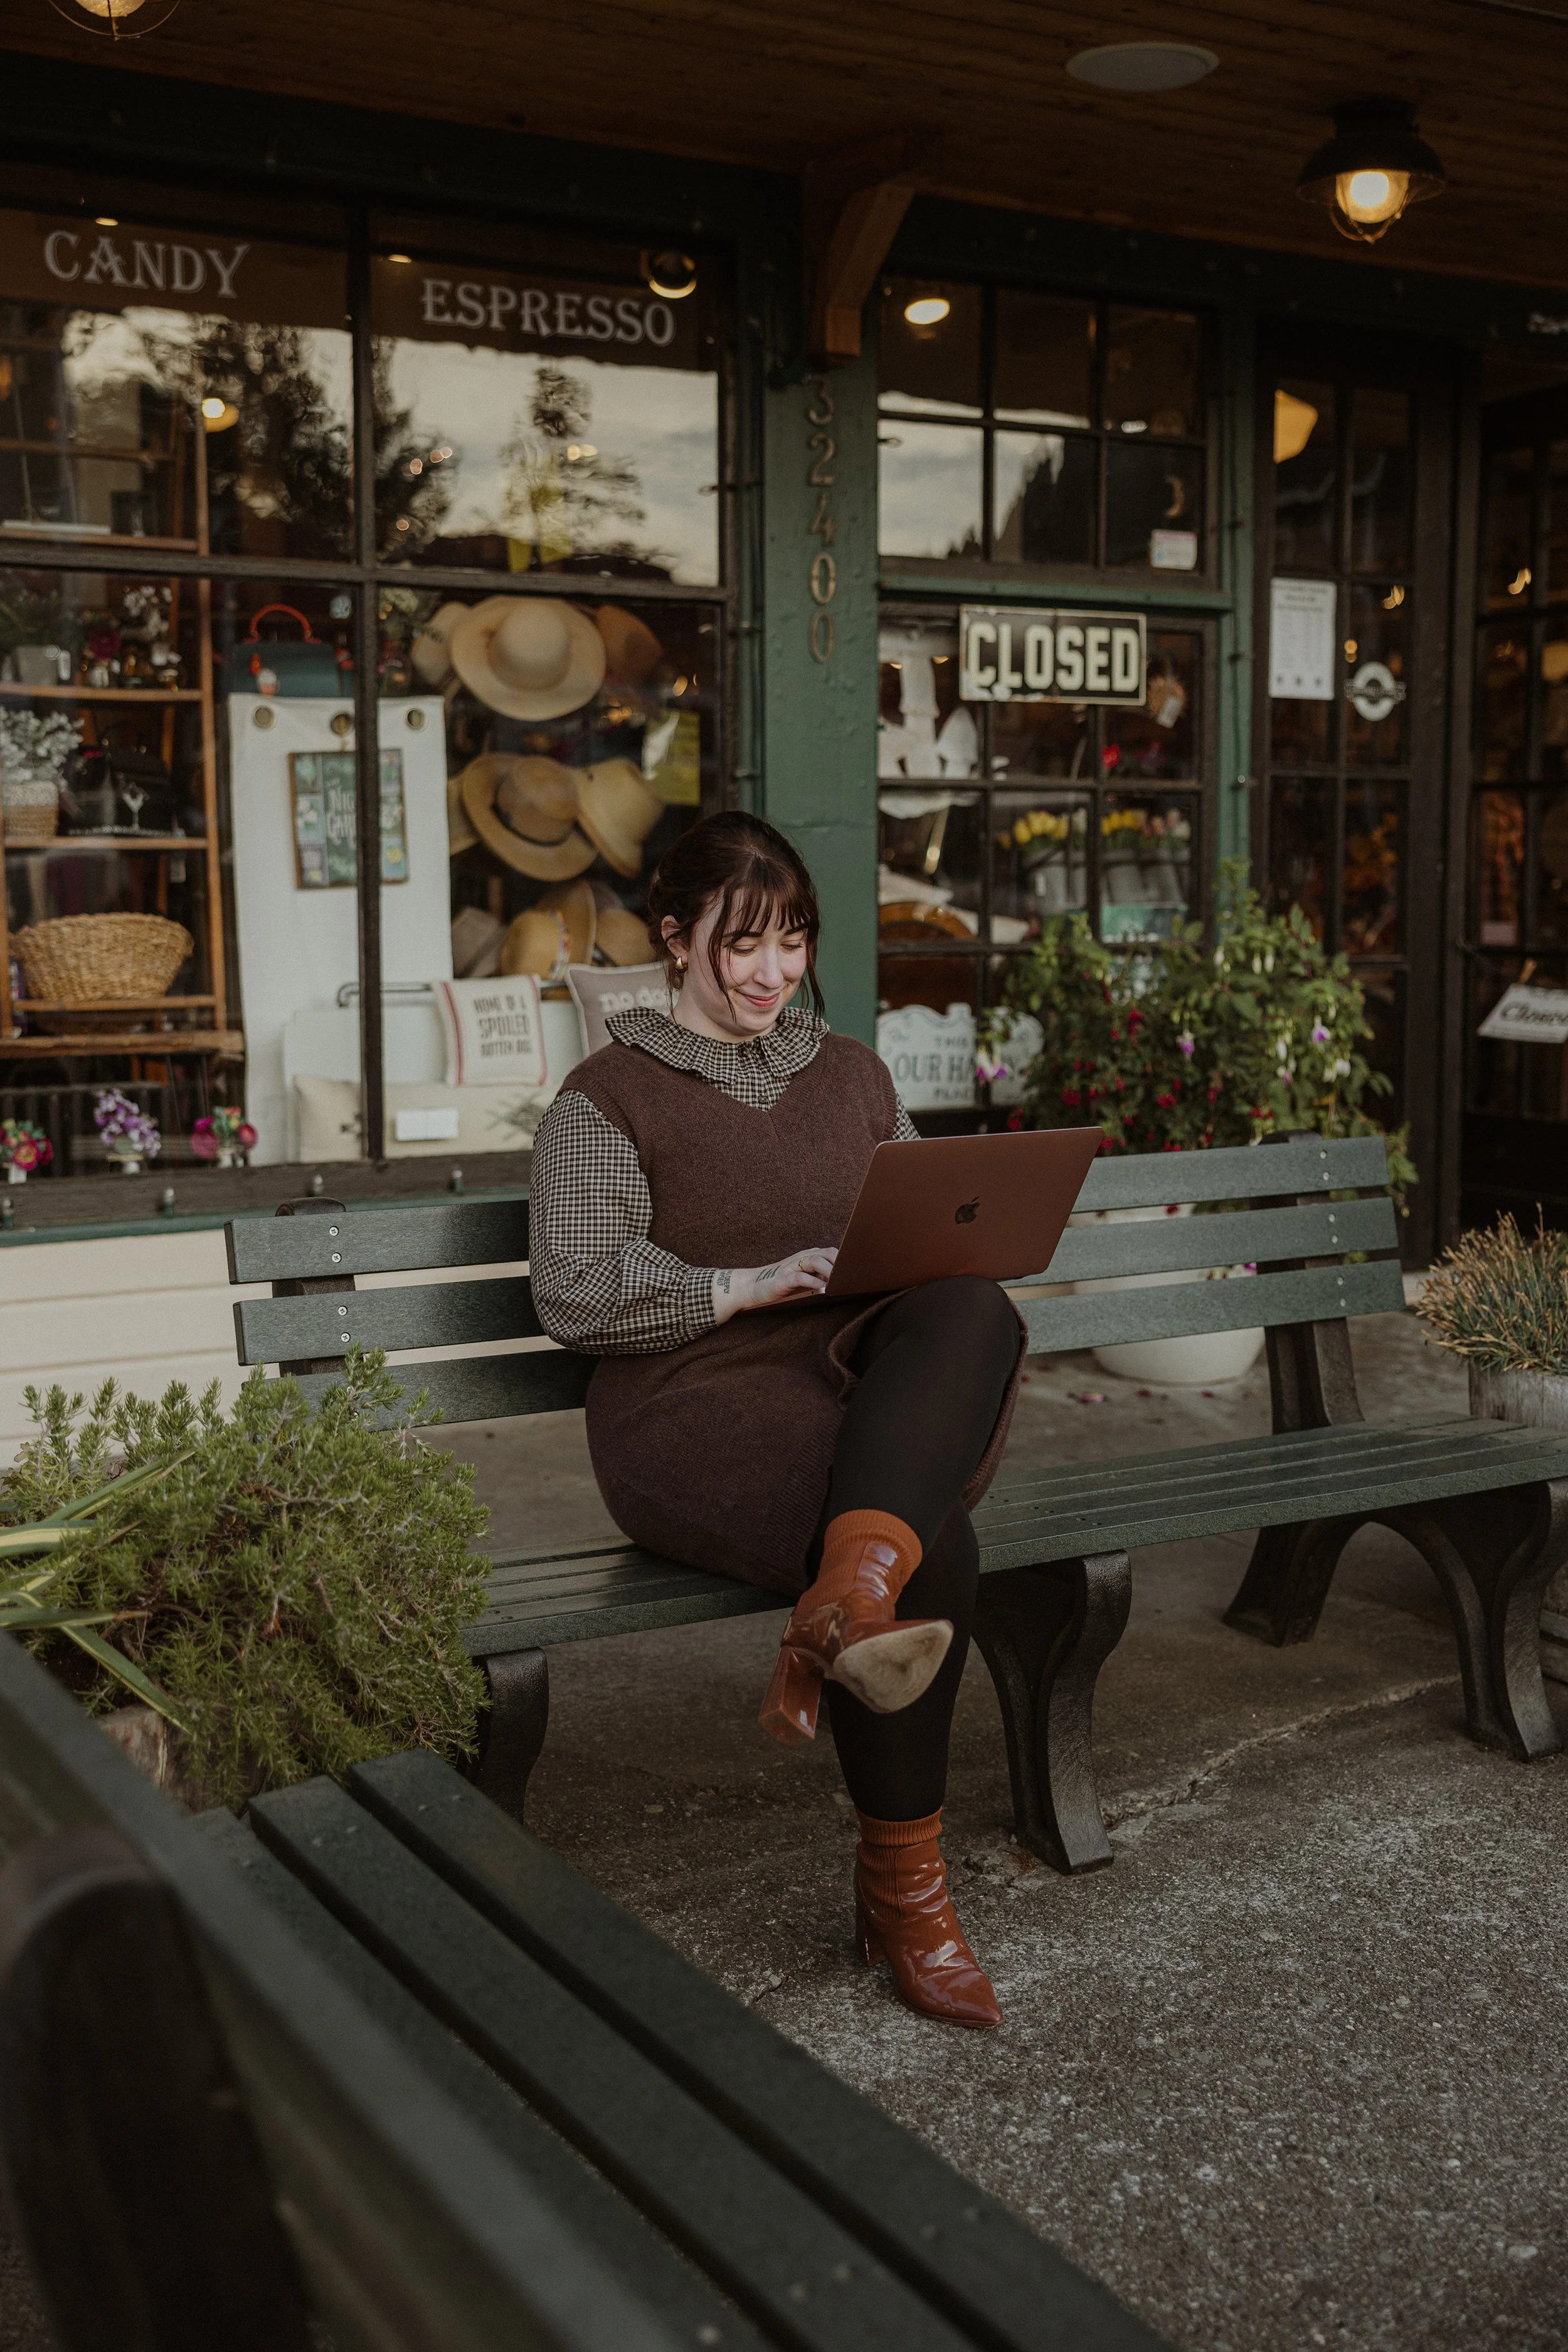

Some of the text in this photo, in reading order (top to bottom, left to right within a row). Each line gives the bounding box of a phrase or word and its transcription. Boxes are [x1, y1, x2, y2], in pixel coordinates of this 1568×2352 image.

[43, 230, 252, 299] CANDY
[421, 277, 676, 346] ESPRESSO
[967, 622, 1140, 692] CLOSED
[894, 1052, 943, 1083] OUR
